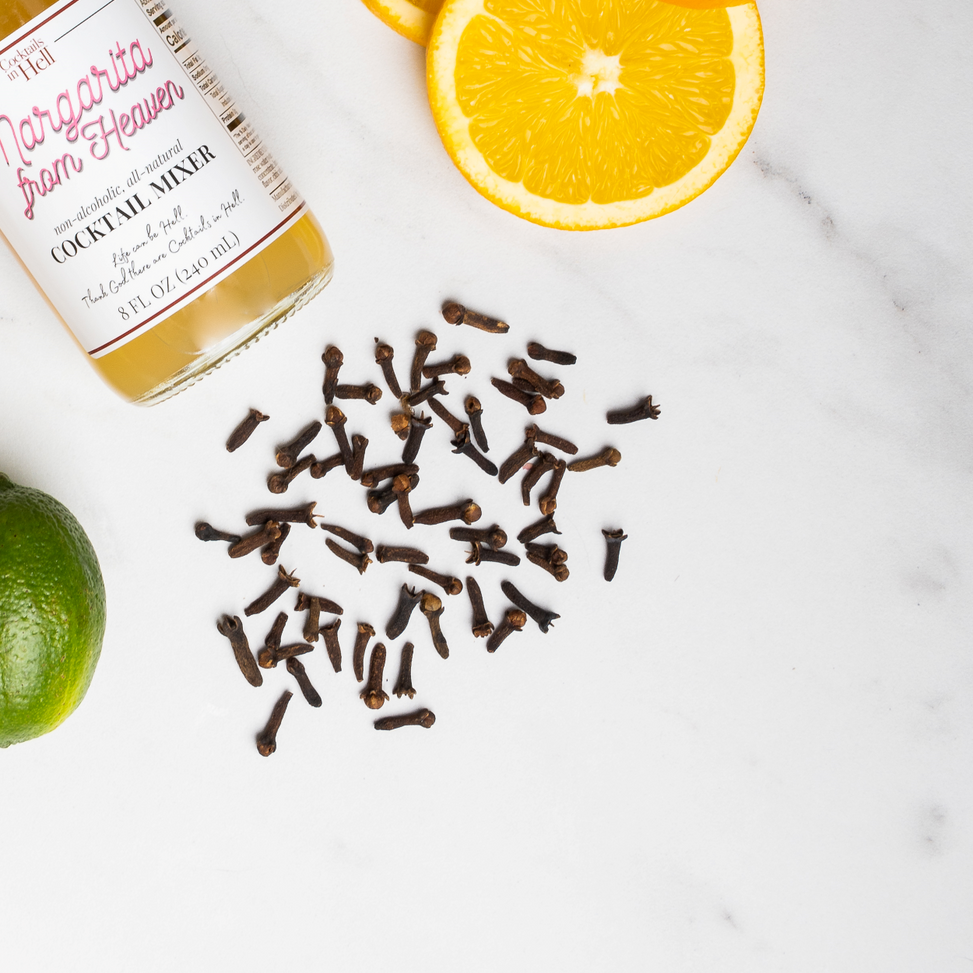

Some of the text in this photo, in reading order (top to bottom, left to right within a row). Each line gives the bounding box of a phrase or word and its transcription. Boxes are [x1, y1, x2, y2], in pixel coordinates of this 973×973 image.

[0, 38, 45, 72] Cocktails
[7, 45, 56, 81] in Hell
[17, 79, 185, 221] from Heaven
[54, 139, 184, 236] non-alcoholic, all-natural
[51, 144, 217, 264] COCKTAIL MIXER
[81, 283, 108, 309] Thank
[128, 261, 151, 279] there
[153, 253, 167, 265] are
[168, 215, 212, 254] Cocktails
[211, 213, 223, 223] in
[220, 189, 247, 218] Hell.
[112, 205, 189, 268] Life can be Hell.
[117, 230, 242, 321] 8 FL OZ (240 mL)
